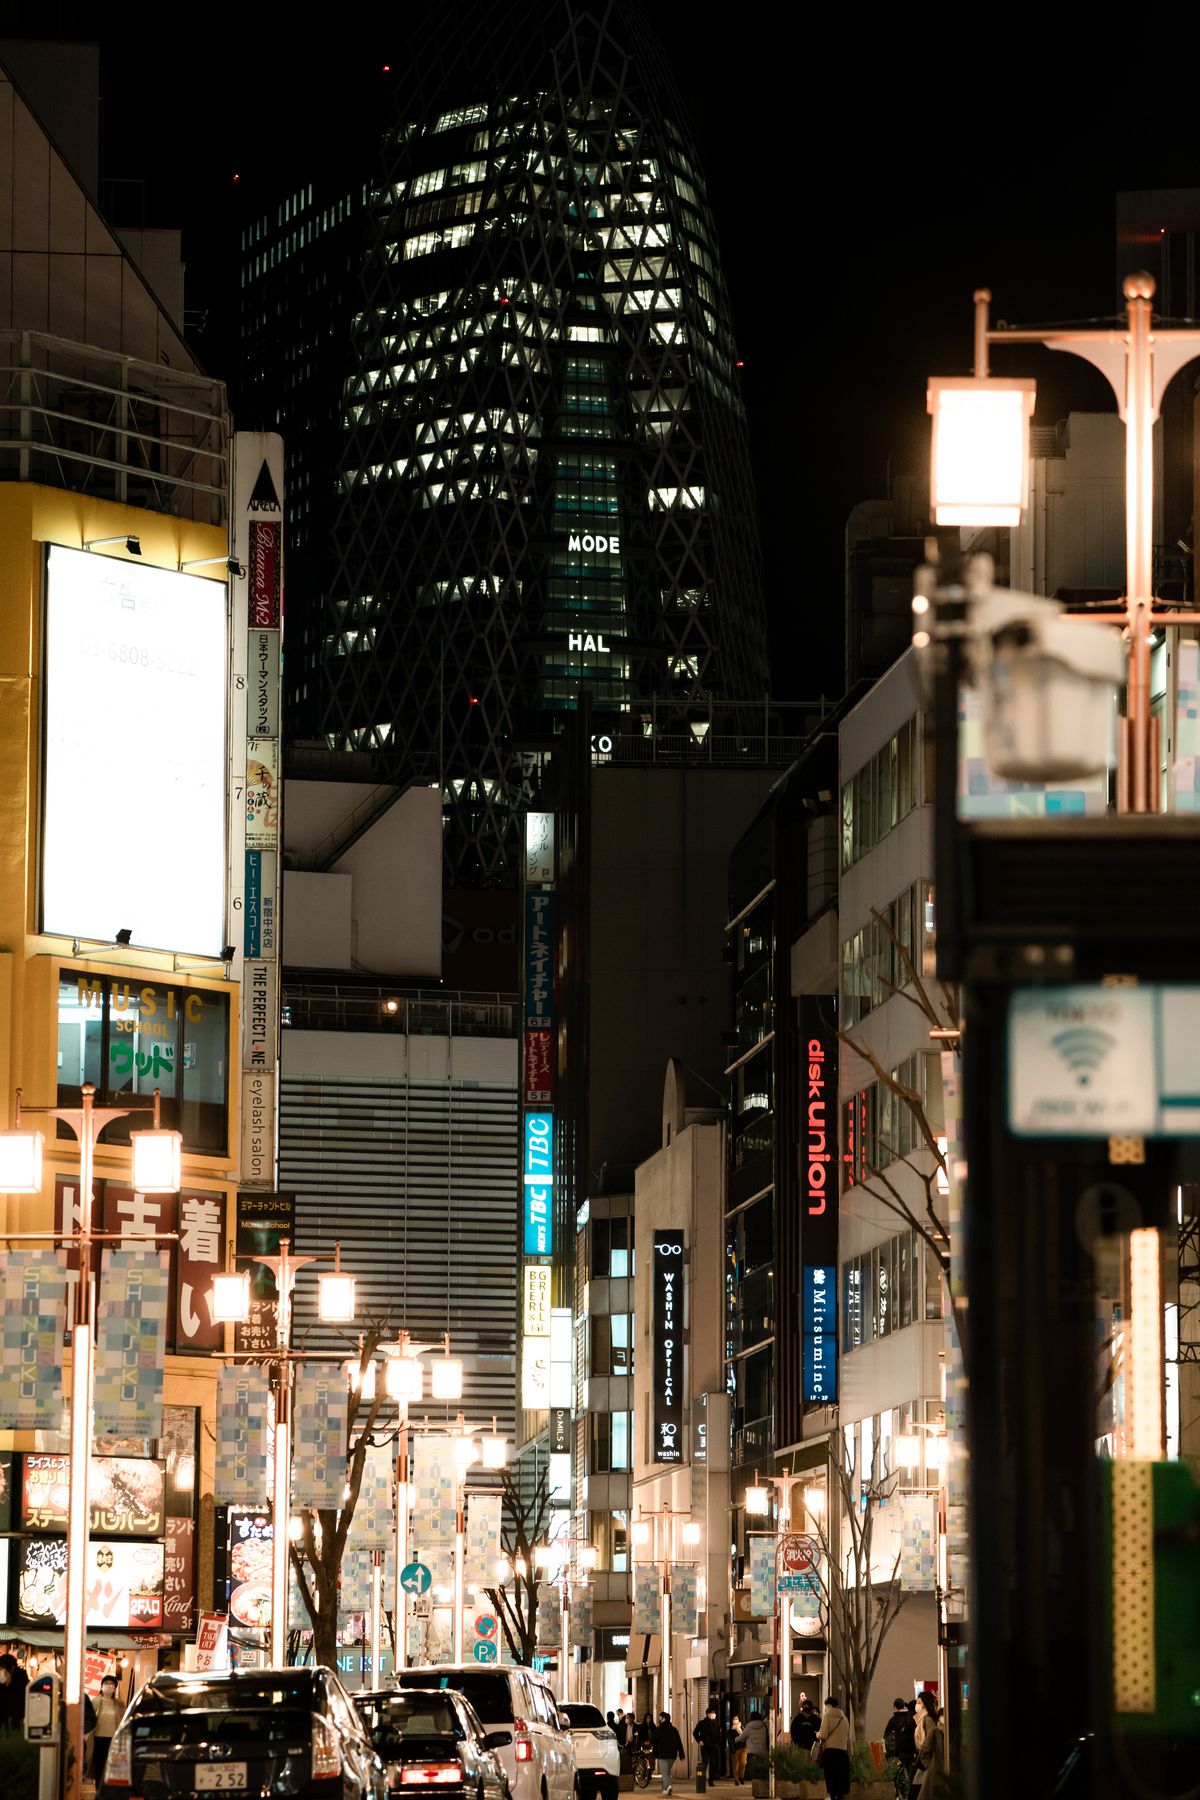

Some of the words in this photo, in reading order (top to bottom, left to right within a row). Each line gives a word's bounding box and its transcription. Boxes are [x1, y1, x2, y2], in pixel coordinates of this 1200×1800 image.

[257, 523, 273, 589] Bianca
[568, 535, 620, 553] MODE
[568, 634, 610, 652] HAL
[236, 677, 244, 690] 8
[248, 741, 260, 751] 7F
[234, 787, 243, 800] 7
[540, 815, 550, 850] パーソル
[233, 896, 242, 910] 6
[263, 897, 273, 949] 新宿中央店
[531, 896, 549, 1016] アートネイチャー
[253, 966, 268, 987] THE
[77, 977, 203, 1024] MUSIC
[252, 990, 267, 1038] PERFECT
[115, 1018, 170, 1039] SCHOOL
[530, 1017, 549, 1027] 6F
[111, 1040, 174, 1079] ウッド
[540, 1032, 551, 1074] レディース
[807, 1038, 825, 1098] disk
[249, 1079, 265, 1134] eyelash
[530, 1091, 547, 1100] 5F
[251, 1136, 266, 1175] salon
[528, 1118, 549, 1170] TBC
[807, 1101, 831, 1216] union
[530, 1186, 547, 1224] TBC
[529, 1271, 537, 1310] BEER
[538, 1271, 547, 1322] GRILL
[663, 1273, 675, 1330] WASHIN
[20, 1267, 40, 1398] SHINJUKU
[121, 1269, 143, 1401] SHINJUKU
[240, 1326, 270, 1337] お売り
[813, 1289, 826, 1393] Mitsumine
[664, 1339, 674, 1406] OPTICAL
[234, 1379, 249, 1480] SHINJUKU
[314, 1379, 328, 1481] SHINJUKU
[657, 1450, 680, 1458] washin
[26, 1508, 160, 1532] ステーハンバーグ
[130, 1598, 160, 1615] 2F入口
[181, 1615, 193, 1629] 3F
